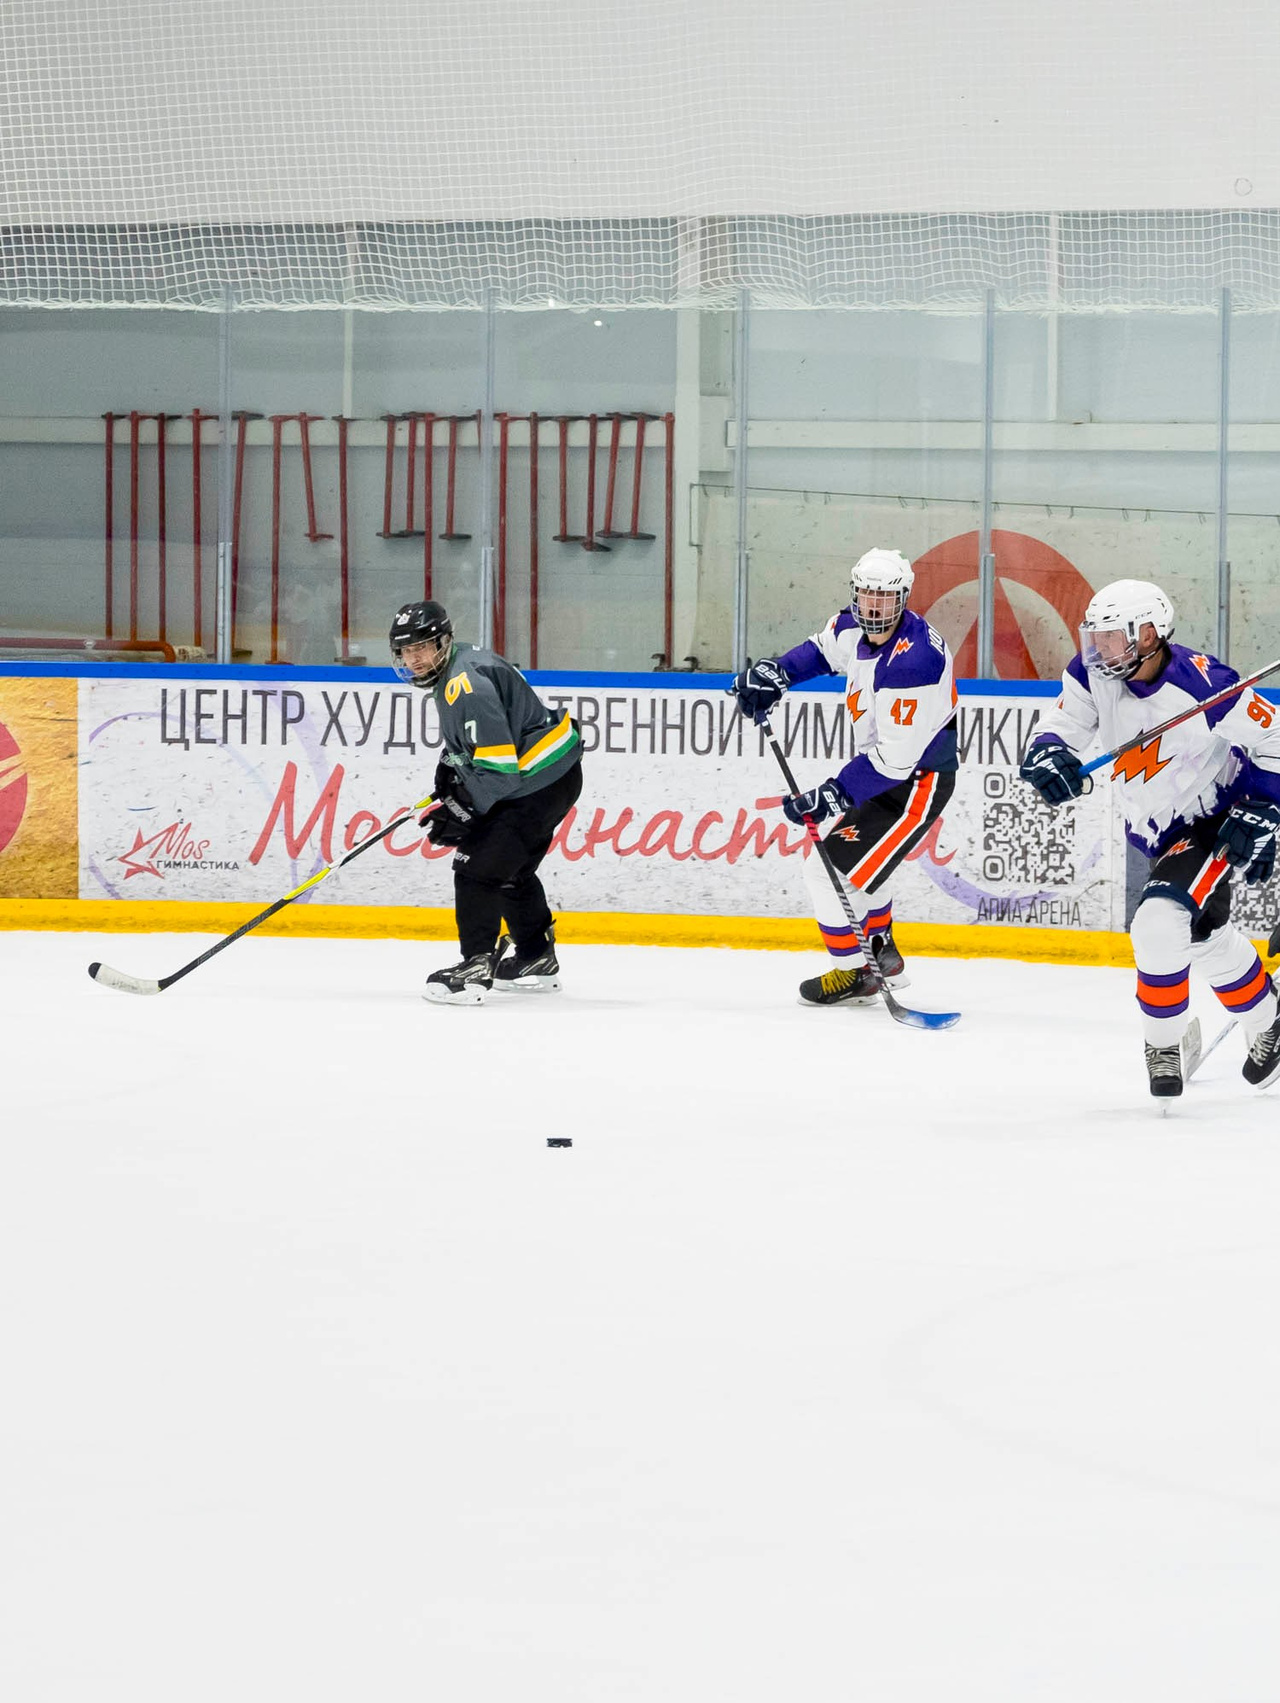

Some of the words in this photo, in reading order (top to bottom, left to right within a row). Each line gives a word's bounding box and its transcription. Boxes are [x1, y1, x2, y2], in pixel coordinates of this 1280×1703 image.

[160, 687, 305, 751] ЦЕНТР
[890, 698, 918, 726] 47
[465, 719, 478, 744] 7
[1231, 808, 1277, 831] CCM
[149, 821, 210, 860] Mos
[156, 859, 240, 871] ГИМНАСТИКА
[1027, 897, 1081, 927] АРЕНА
